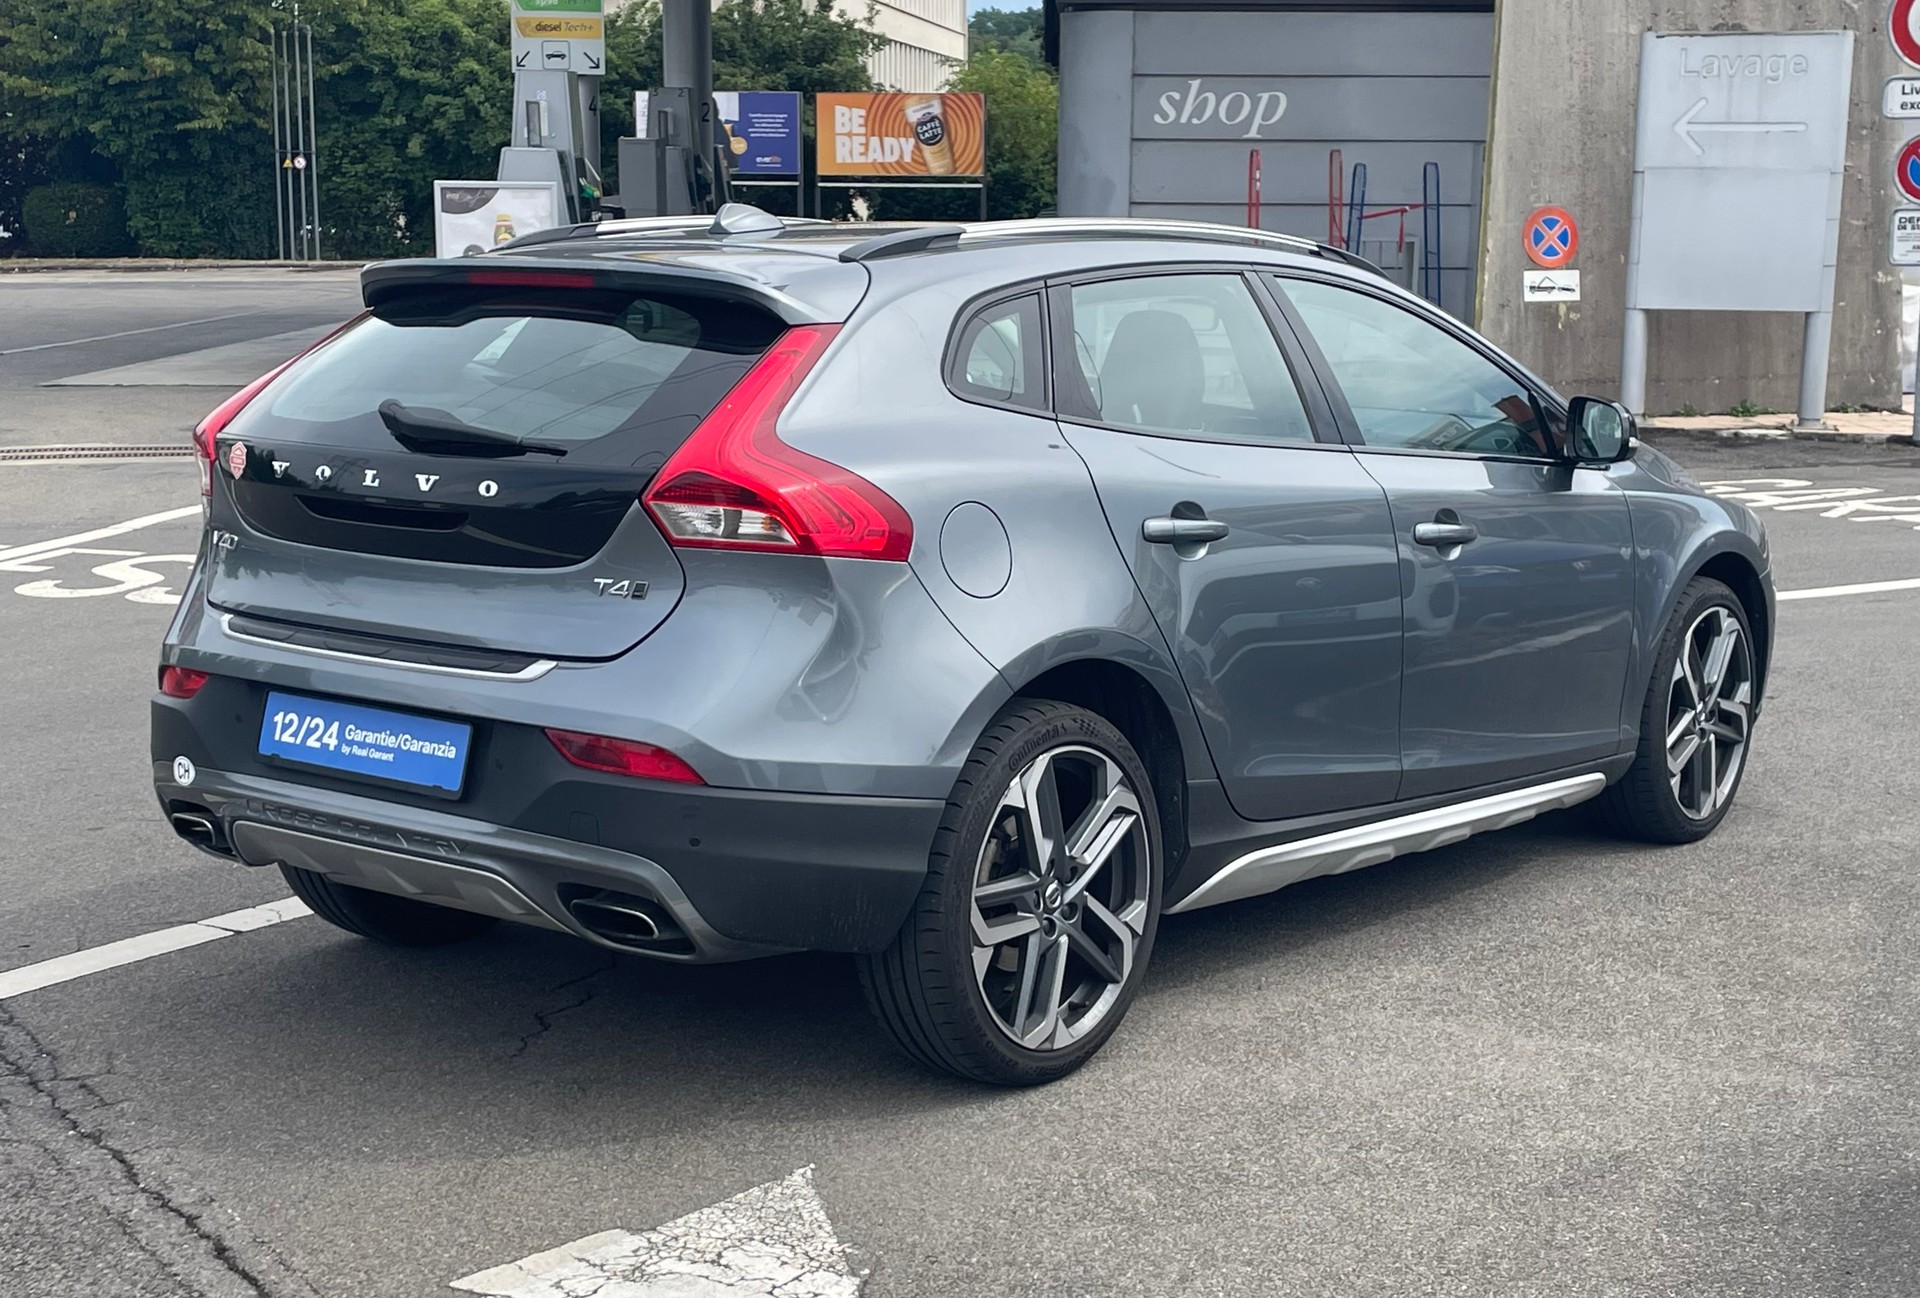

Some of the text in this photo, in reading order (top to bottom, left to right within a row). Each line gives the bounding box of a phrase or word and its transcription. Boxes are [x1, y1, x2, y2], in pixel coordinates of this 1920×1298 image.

[535, 21, 594, 32] diesel Tech+
[1680, 47, 1809, 84] Lavage
[589, 96, 597, 117] 4
[701, 102, 710, 122] 2
[1153, 78, 1288, 138] shop
[834, 105, 867, 134] BE
[919, 127, 943, 140] LATTE
[835, 135, 915, 163] READY
[271, 460, 499, 498] VOLVO
[593, 577, 631, 599] T4
[272, 711, 457, 760] 12/24 Garantie/Garanzia
[1008, 722, 1061, 772] Continental
[340, 743, 394, 763] by Real Garant
[178, 761, 190, 780] CH
